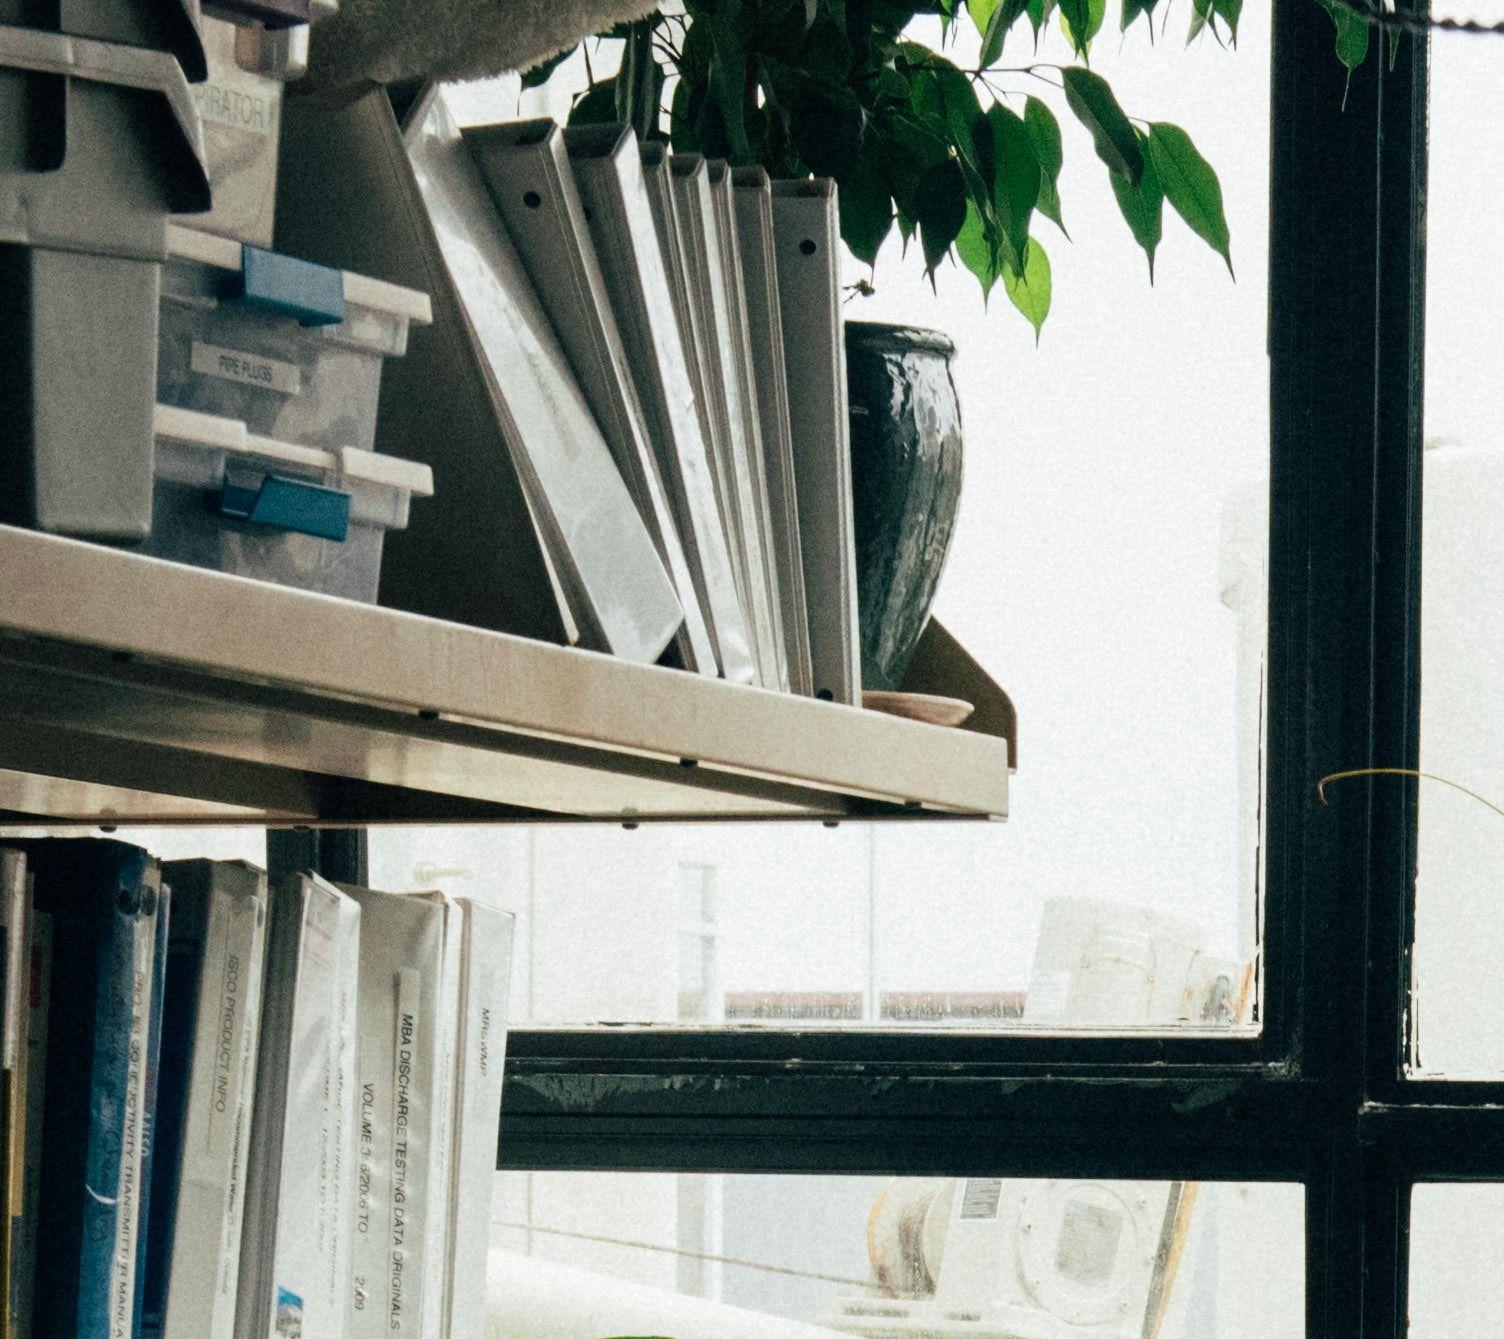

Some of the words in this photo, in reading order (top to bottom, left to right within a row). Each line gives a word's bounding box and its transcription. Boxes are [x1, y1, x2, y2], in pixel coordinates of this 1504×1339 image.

[226, 954, 239, 992] ISCO
[218, 995, 236, 1073] PRODUCT
[401, 1013, 413, 1045] MBA
[214, 1075, 228, 1113] INFO
[360, 1082, 374, 1143] VOLUME
[396, 1050, 411, 1134] DISCHARGE
[394, 1141, 407, 1203] TESTING
[358, 1213, 368, 1233] TO
[392, 1206, 404, 1245] DATA
[390, 1250, 403, 1330] ORIGINALS
